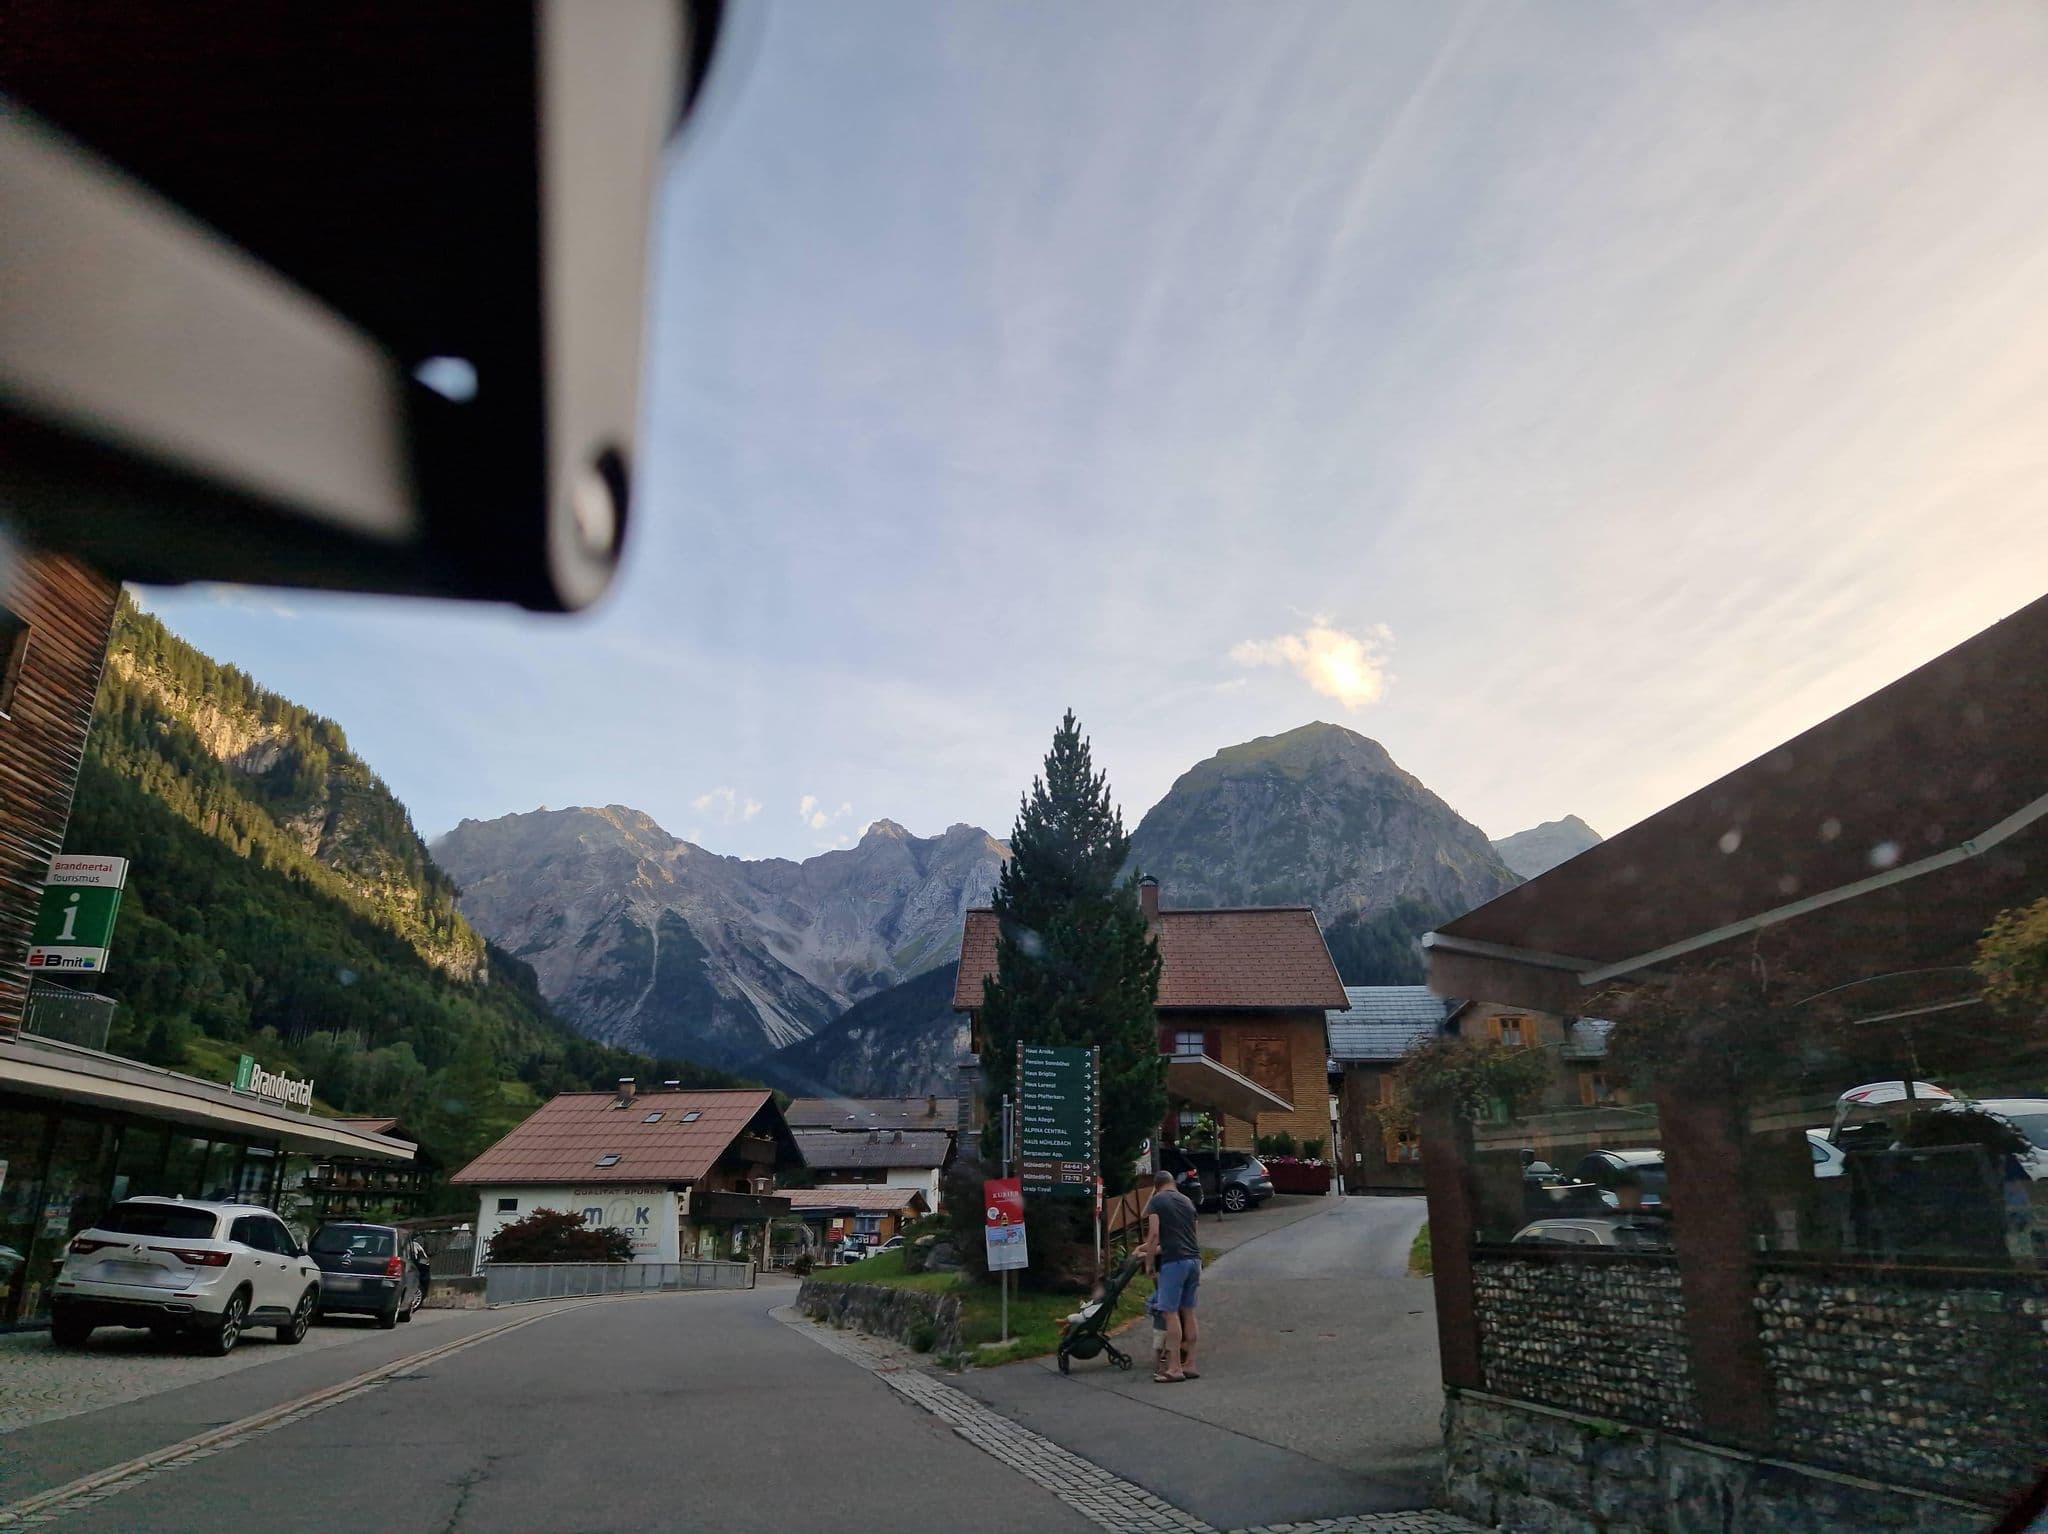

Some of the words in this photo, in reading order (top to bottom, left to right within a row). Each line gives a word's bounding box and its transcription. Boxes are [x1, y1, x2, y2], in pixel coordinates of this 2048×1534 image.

[54, 862, 113, 872] Brandnertal
[53, 874, 100, 883] Tourismus
[250, 1063, 314, 1106] Brandnertal
